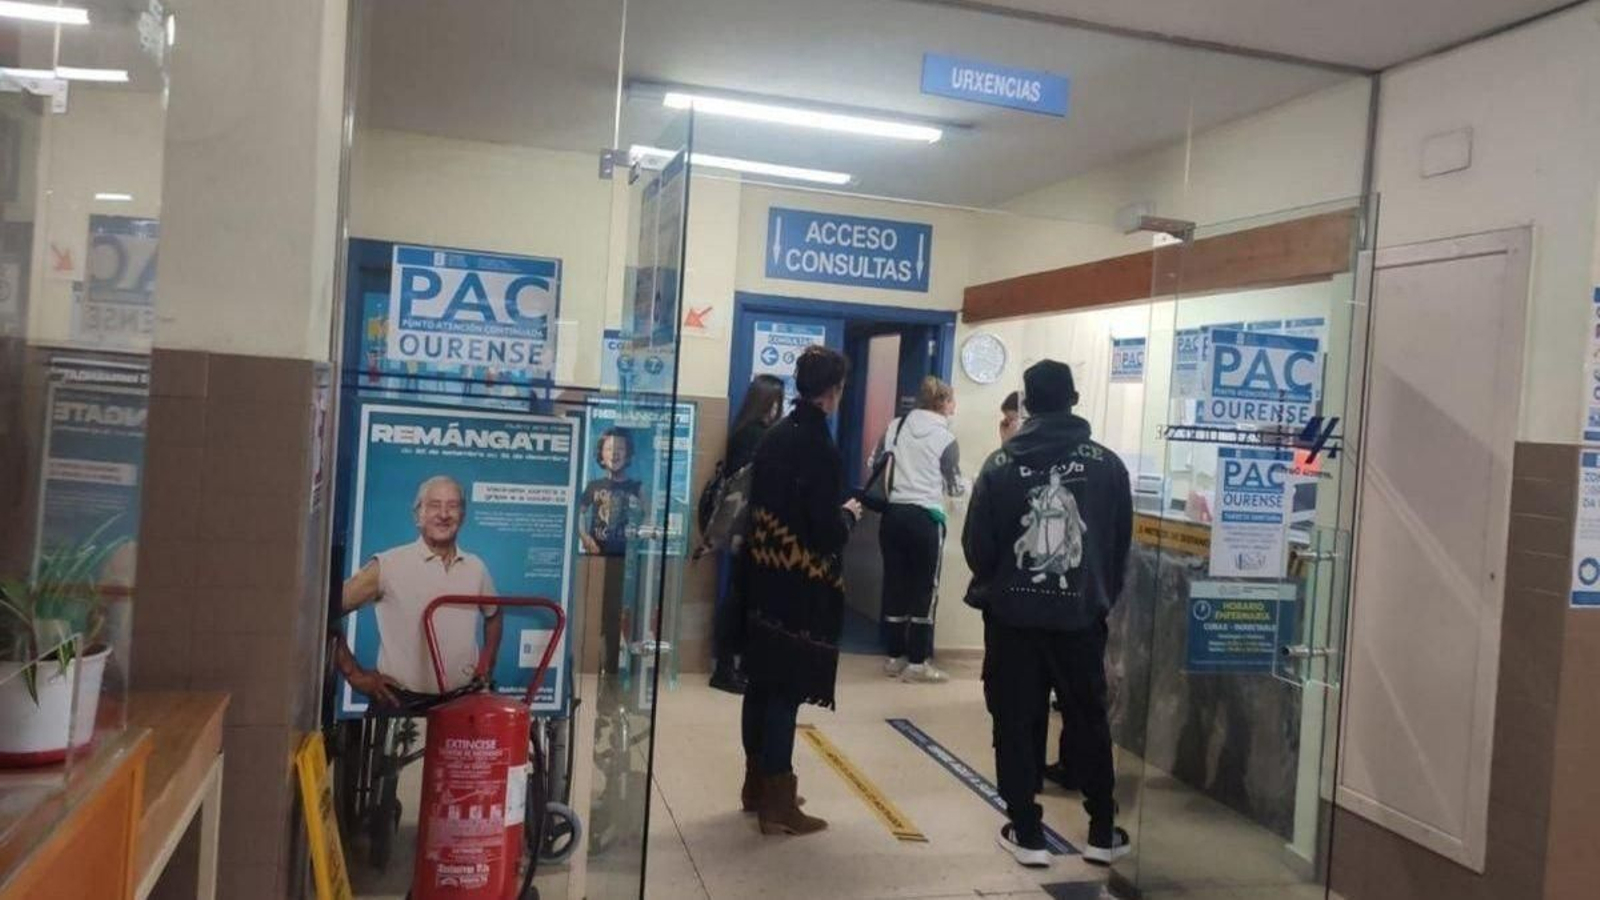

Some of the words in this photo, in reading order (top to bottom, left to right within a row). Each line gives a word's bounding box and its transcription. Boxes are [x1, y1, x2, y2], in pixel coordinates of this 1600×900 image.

[951, 67, 1042, 102] URXENCIAS
[805, 221, 898, 251] ACCESO
[785, 249, 912, 282] CONSULTAS
[399, 267, 550, 324] PAC
[402, 318, 435, 329] PUNTO
[400, 334, 544, 365] OURENSE
[1122, 351, 1145, 366] PAC
[1177, 336, 1199, 352] PAC
[1212, 345, 1315, 391] PAC
[1212, 400, 1310, 424] OURENSE
[371, 421, 570, 453] REMÁNGATE
[1223, 460, 1286, 489] PAC
[1223, 493, 1282, 508] OURENSE
